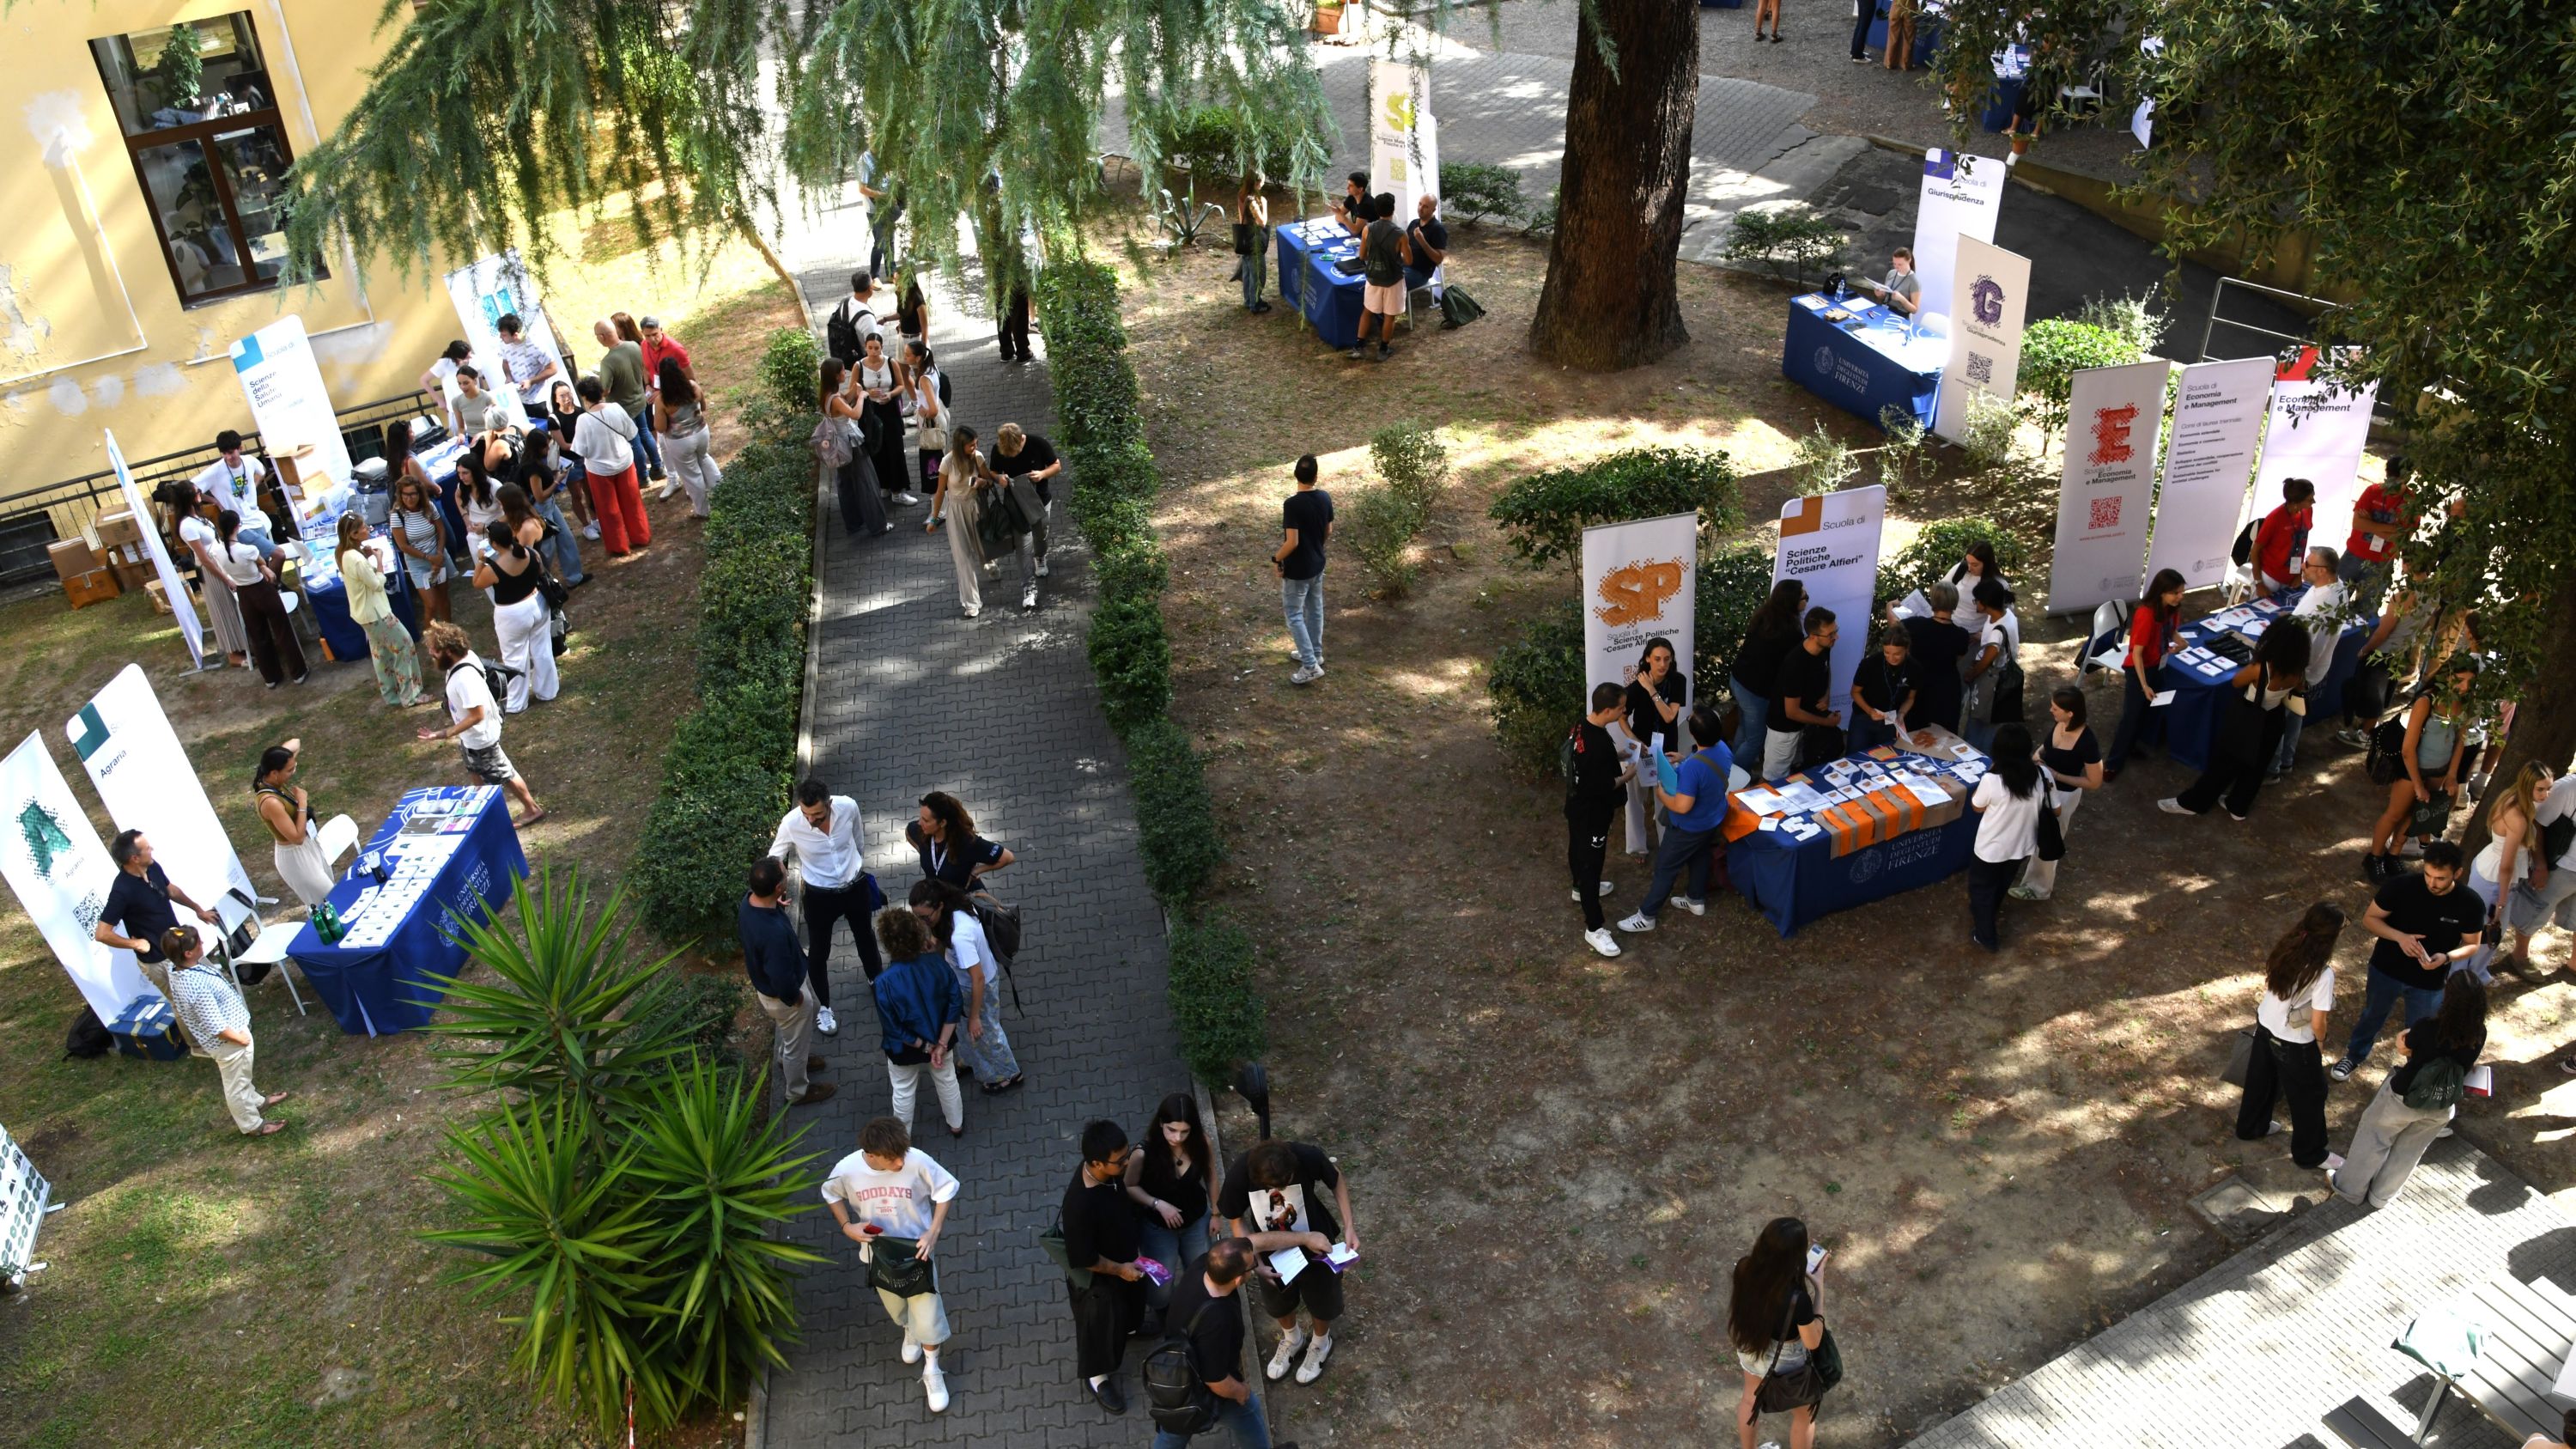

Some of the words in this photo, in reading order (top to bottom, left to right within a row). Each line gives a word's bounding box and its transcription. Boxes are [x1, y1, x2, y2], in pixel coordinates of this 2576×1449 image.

[1383, 90, 1415, 132] S
[1928, 187, 1984, 206] Giurispudenza
[1971, 275, 2005, 328] G
[1966, 326, 2006, 347] Giurisprudenza
[249, 371, 276, 388] Scienze
[1835, 371, 1867, 394] FIRENZE
[2187, 383, 2209, 392] Scuola
[252, 382, 270, 395] della
[254, 387, 276, 402] Salute
[2186, 391, 2221, 400] Economia
[258, 393, 283, 408] Umana
[2191, 397, 2238, 409] Management
[2279, 395, 2329, 404] Economa
[2287, 404, 2351, 412] Management
[2088, 404, 2138, 466] E
[2092, 473, 2136, 484] Management
[2098, 469, 2131, 478] Economia
[1822, 518, 1855, 531] Scuola
[1856, 515, 1865, 524] di
[1786, 546, 1827, 558] Scienze
[1786, 553, 1831, 567] Politiche
[1595, 558, 1686, 628] SP
[1607, 630, 1631, 641] Scuola
[1614, 636, 1643, 645] Scienze
[1645, 629, 1680, 639] Politiche
[100, 750, 127, 778] Agraria
[18, 796, 73, 880] A
[1888, 845, 1939, 870] FIRENZE
[64, 856, 85, 879] Agraria
[459, 889, 474, 910] DEGL
[465, 876, 492, 916] IRENZE
